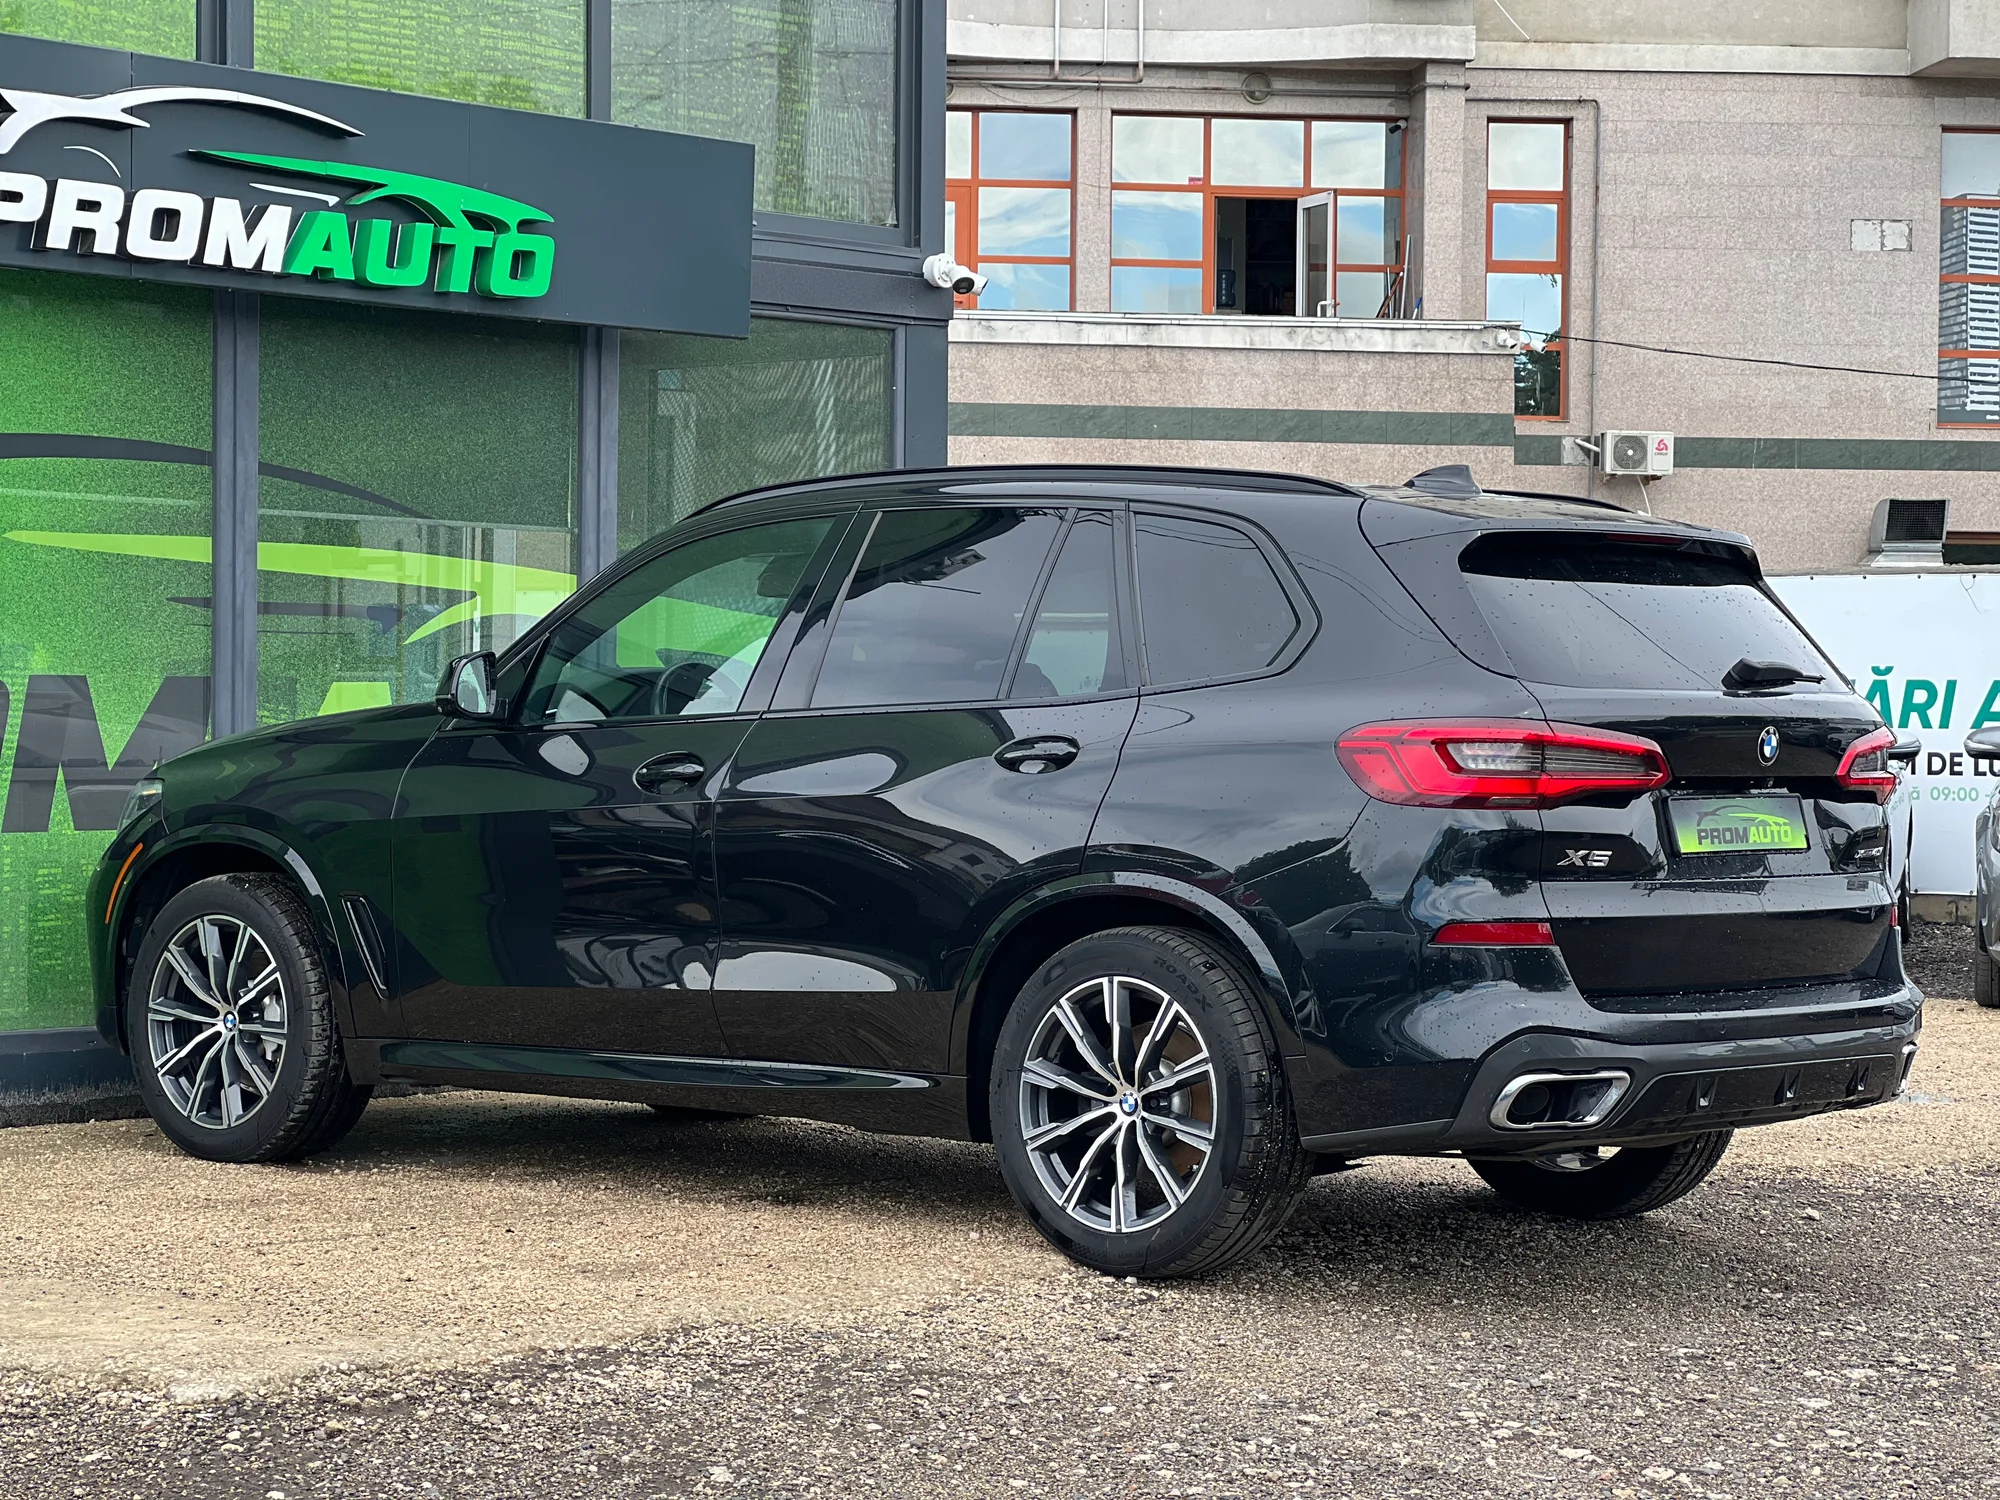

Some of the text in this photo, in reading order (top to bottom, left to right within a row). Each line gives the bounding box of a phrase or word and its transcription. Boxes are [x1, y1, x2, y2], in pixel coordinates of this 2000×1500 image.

[1851, 665, 1958, 729] ĂRI
[1927, 752, 1964, 776] DE
[1929, 786, 1980, 802] 09:00
[1697, 825, 1793, 846] PROMAUTO
[1556, 849, 1613, 867] X5
